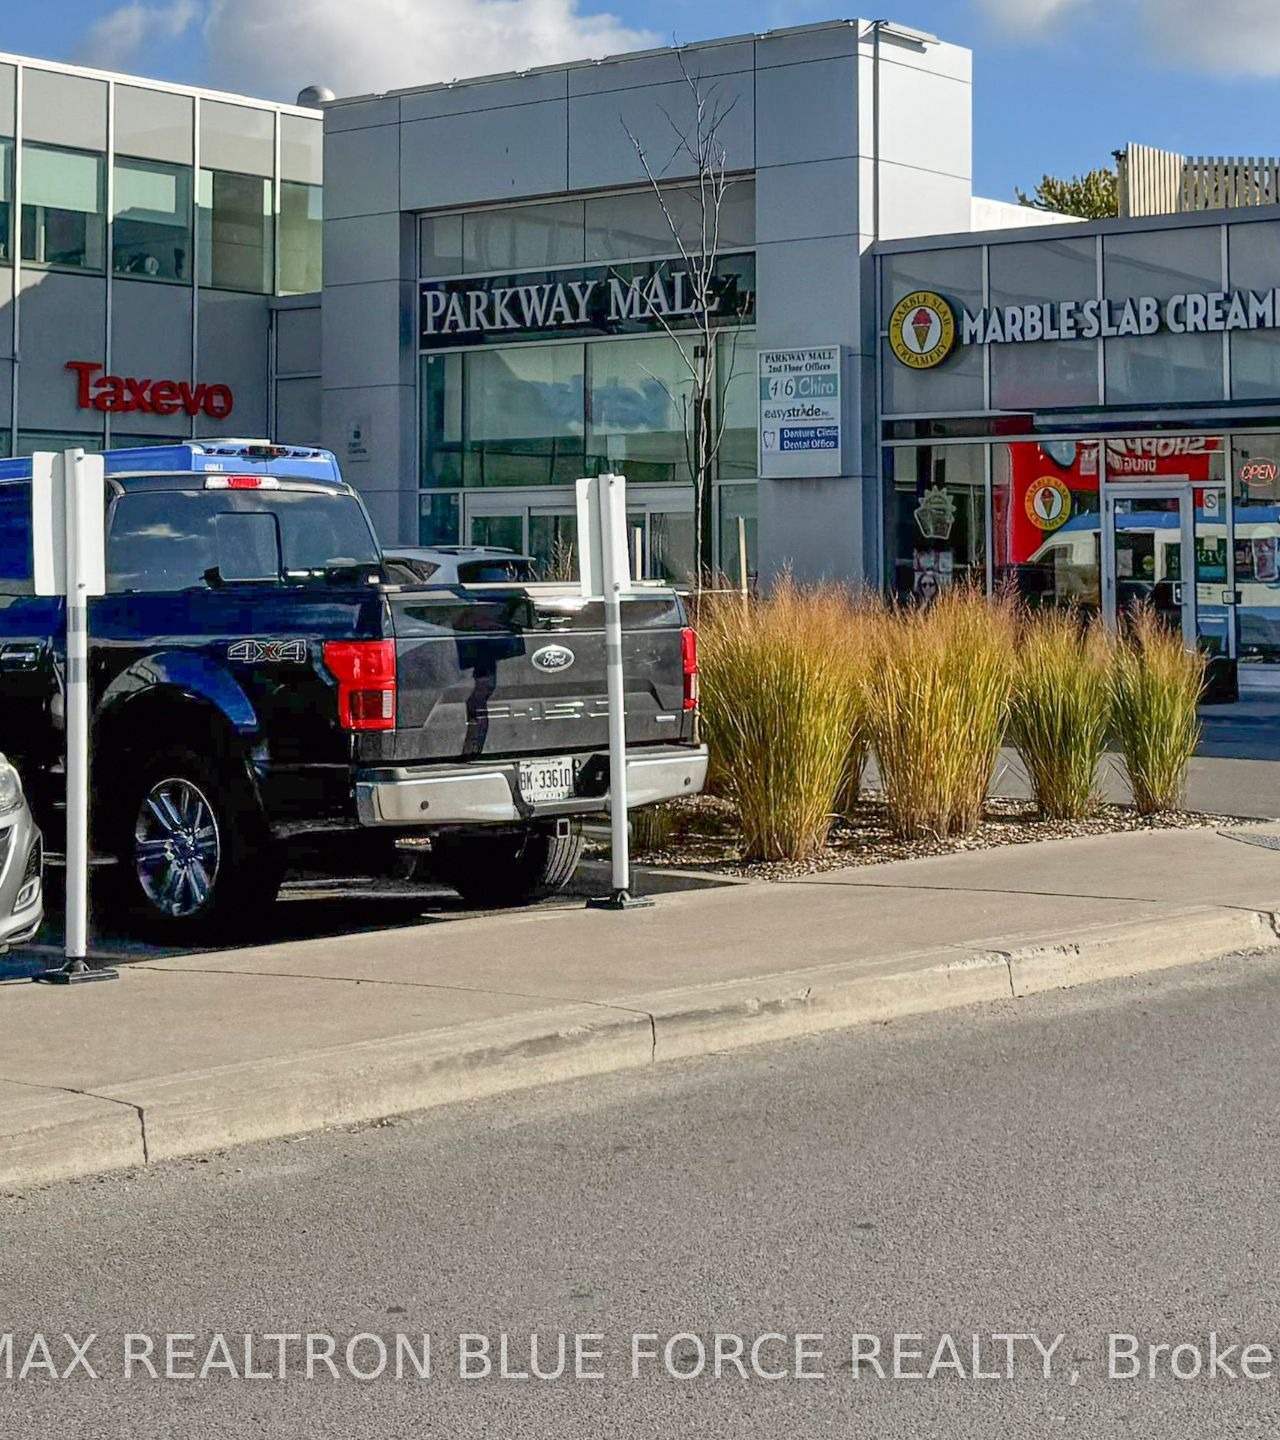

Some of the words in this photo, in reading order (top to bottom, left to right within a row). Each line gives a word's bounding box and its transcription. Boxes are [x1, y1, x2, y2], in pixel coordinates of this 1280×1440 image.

[422, 279, 599, 336] PARKWAY
[606, 270, 721, 321] MALL
[962, 301, 1076, 345] MARBLE
[1082, 296, 1160, 339] SLAB
[765, 352, 807, 363] PARKWAY
[808, 350, 835, 360] MALL
[895, 343, 948, 365] CREAMERY
[768, 364, 782, 373] 2nd
[784, 363, 803, 372] Floor
[805, 362, 831, 371] Offices
[64, 360, 234, 421] Taxevo
[799, 376, 835, 395] Chiro
[783, 428, 815, 438] Denture
[816, 426, 839, 437] Clinic
[783, 439, 810, 449] Dental
[811, 439, 836, 448] Office
[1241, 464, 1277, 479] OPEN
[543, 651, 567, 666] Ford
